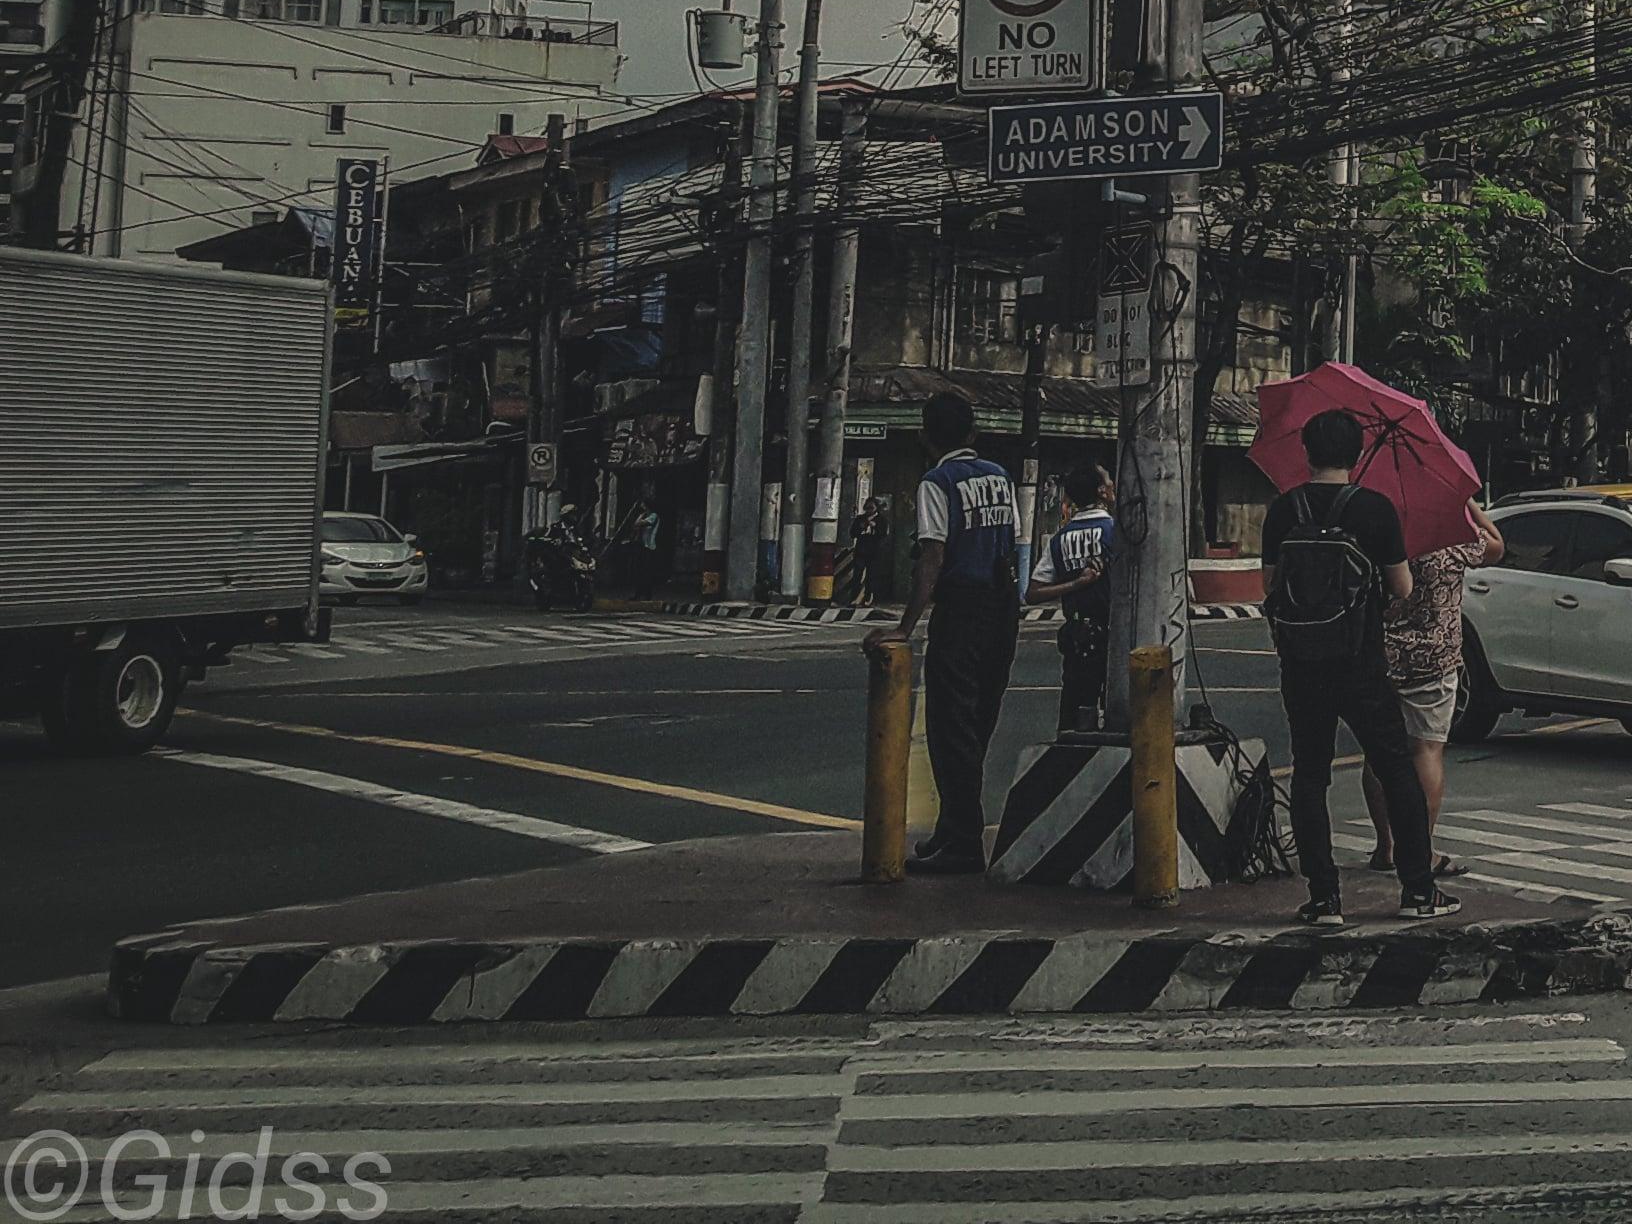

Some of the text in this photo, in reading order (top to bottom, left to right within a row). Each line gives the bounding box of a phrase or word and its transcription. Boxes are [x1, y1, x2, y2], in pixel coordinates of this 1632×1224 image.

[998, 21, 1056, 50] NO
[972, 53, 1082, 79] LEFT TURN
[1005, 108, 1169, 145] ADAMSON
[998, 141, 1175, 173] UNIVERSITY
[956, 475, 1011, 511] MTPB
[1060, 527, 1103, 559] MTPB
